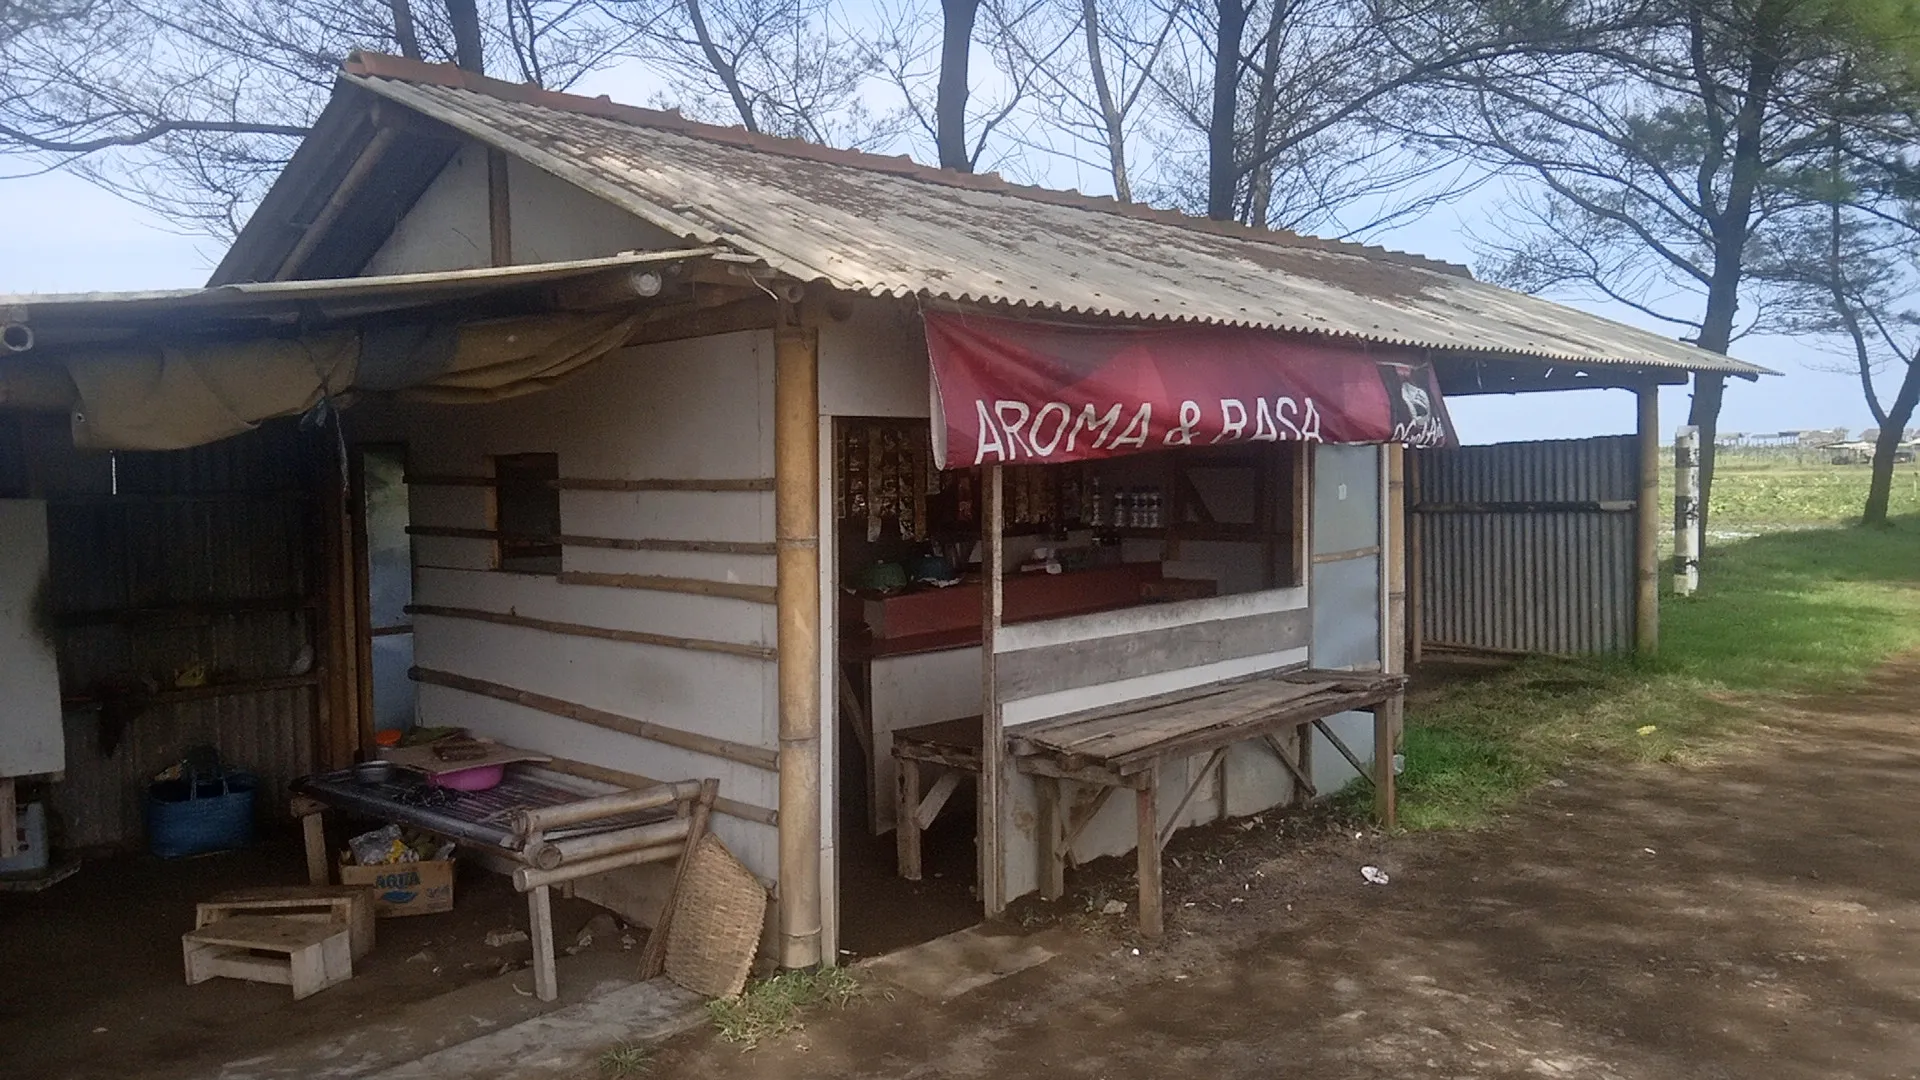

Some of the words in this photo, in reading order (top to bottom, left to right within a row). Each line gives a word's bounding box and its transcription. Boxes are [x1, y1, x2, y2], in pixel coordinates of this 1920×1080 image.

[974, 399, 1151, 465] AROMA
[1163, 400, 1201, 446] &
[1210, 397, 1323, 444] RASA
[376, 871, 421, 889] AQUA
